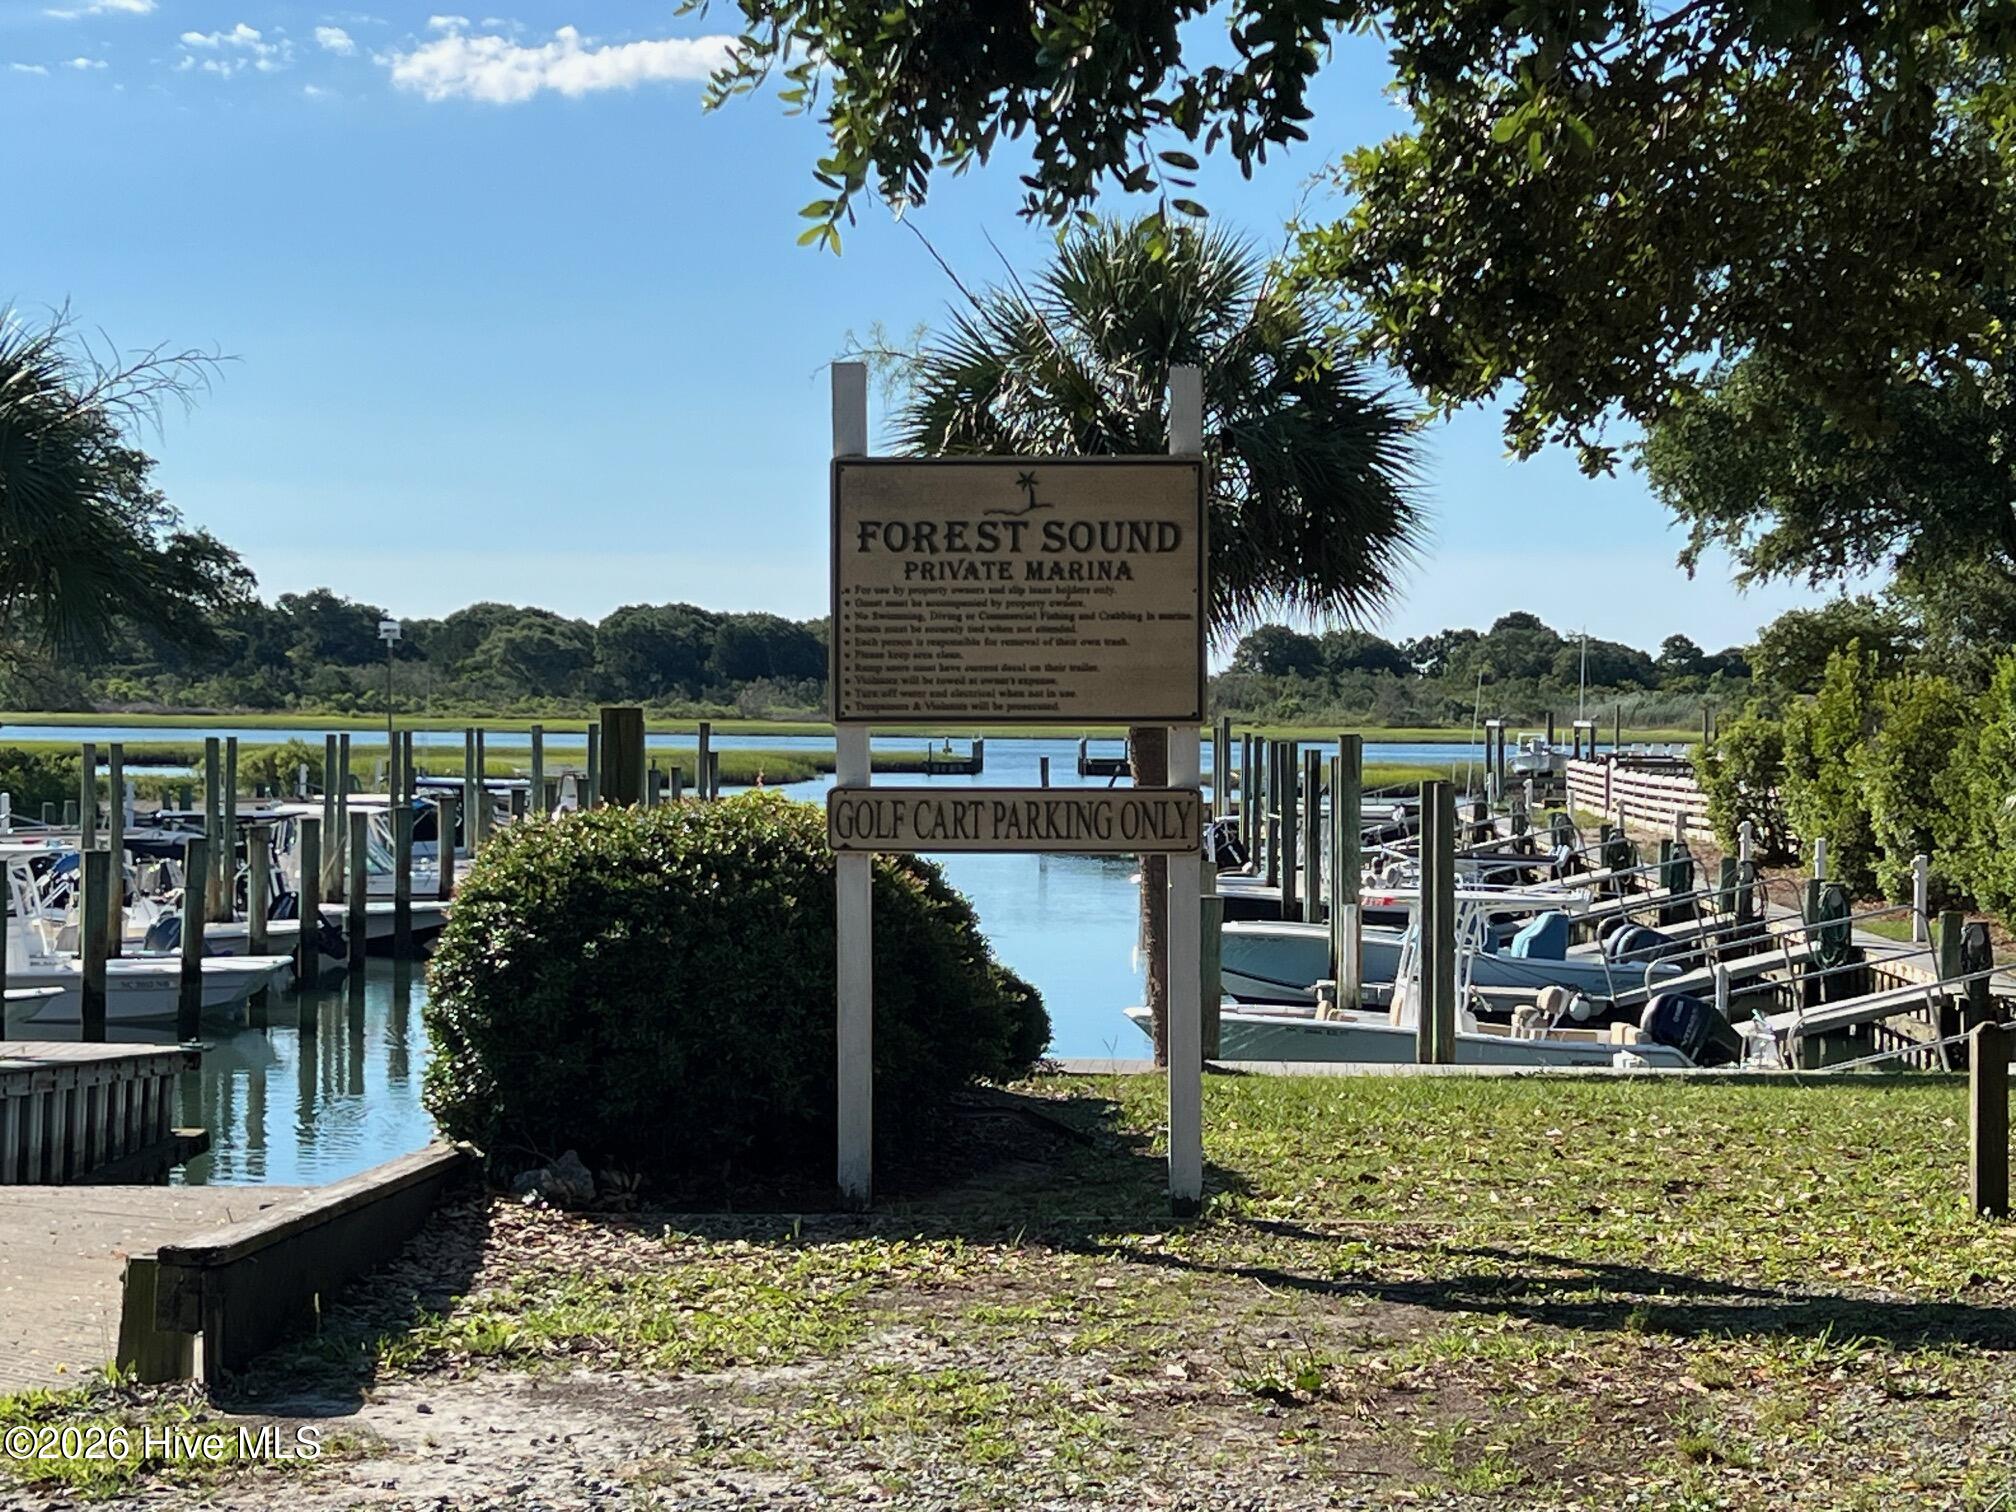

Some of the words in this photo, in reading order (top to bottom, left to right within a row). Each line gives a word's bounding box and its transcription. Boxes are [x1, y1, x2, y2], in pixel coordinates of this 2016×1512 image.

[857, 520, 1030, 556] FOREST
[1040, 519, 1182, 554] SOUND
[904, 559, 1014, 582] PRIVATE
[1024, 560, 1134, 581] MARINA
[855, 585, 871, 594] For
[908, 585, 948, 596] property
[988, 585, 1005, 594] and
[1005, 598, 1045, 609] property
[930, 611, 962, 622] Diving
[979, 611, 1037, 620] Commercial
[1079, 611, 1096, 620] and
[1099, 611, 1142, 622] Crabbing
[835, 799, 905, 840] GOLF
[913, 801, 985, 840] CART
[993, 801, 1112, 840] PARKING
[1120, 801, 1194, 840] ONLY
